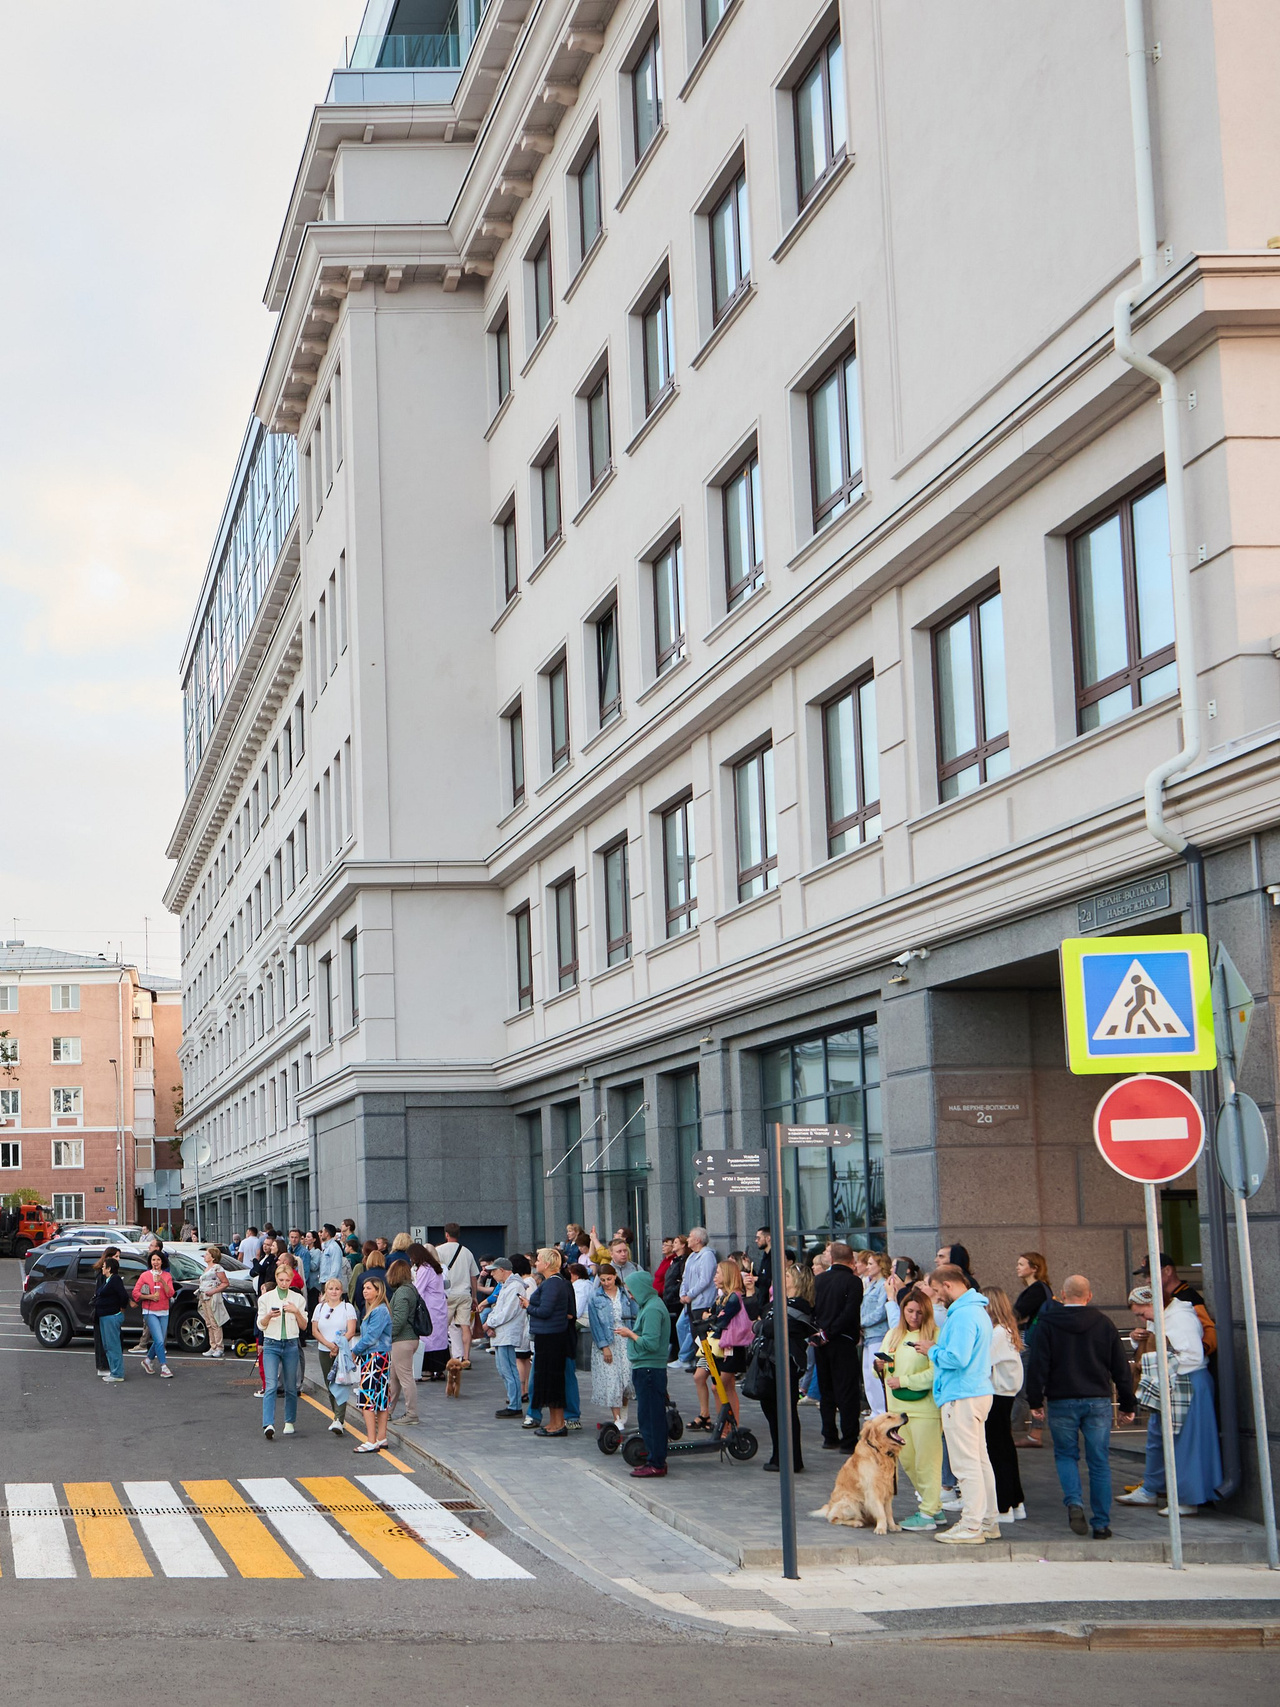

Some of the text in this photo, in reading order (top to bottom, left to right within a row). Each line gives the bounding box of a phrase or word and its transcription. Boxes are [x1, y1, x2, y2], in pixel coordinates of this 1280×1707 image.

[1097, 879, 1165, 908] ВЕРХНЕ-ВОЛЖСКАЯ
[1107, 896, 1156, 919] НАБЕРЕЖНАЯ
[1081, 909, 1092, 923] 2а
[976, 1111, 993, 1123] 2а
[415, 1228, 422, 1237] P
